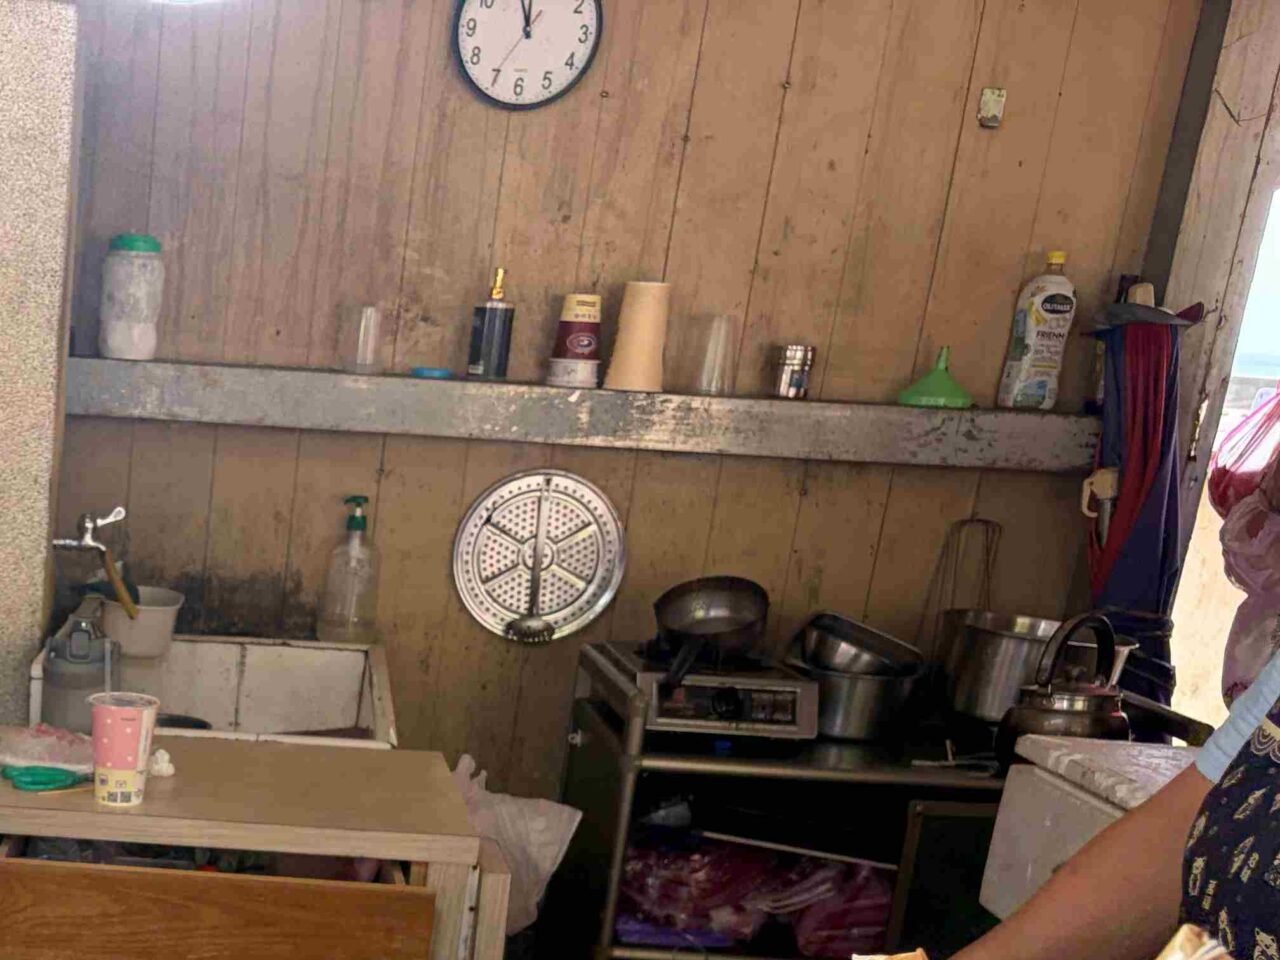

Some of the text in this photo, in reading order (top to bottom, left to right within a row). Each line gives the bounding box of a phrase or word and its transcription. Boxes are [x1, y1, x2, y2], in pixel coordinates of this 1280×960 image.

[466, 18, 477, 37] 9
[578, 24, 589, 43] 3
[470, 46, 481, 65] 8
[564, 52, 575, 71] 4
[491, 68, 501, 87] 7
[513, 77, 525, 96] 6
[541, 71, 553, 90] 5
